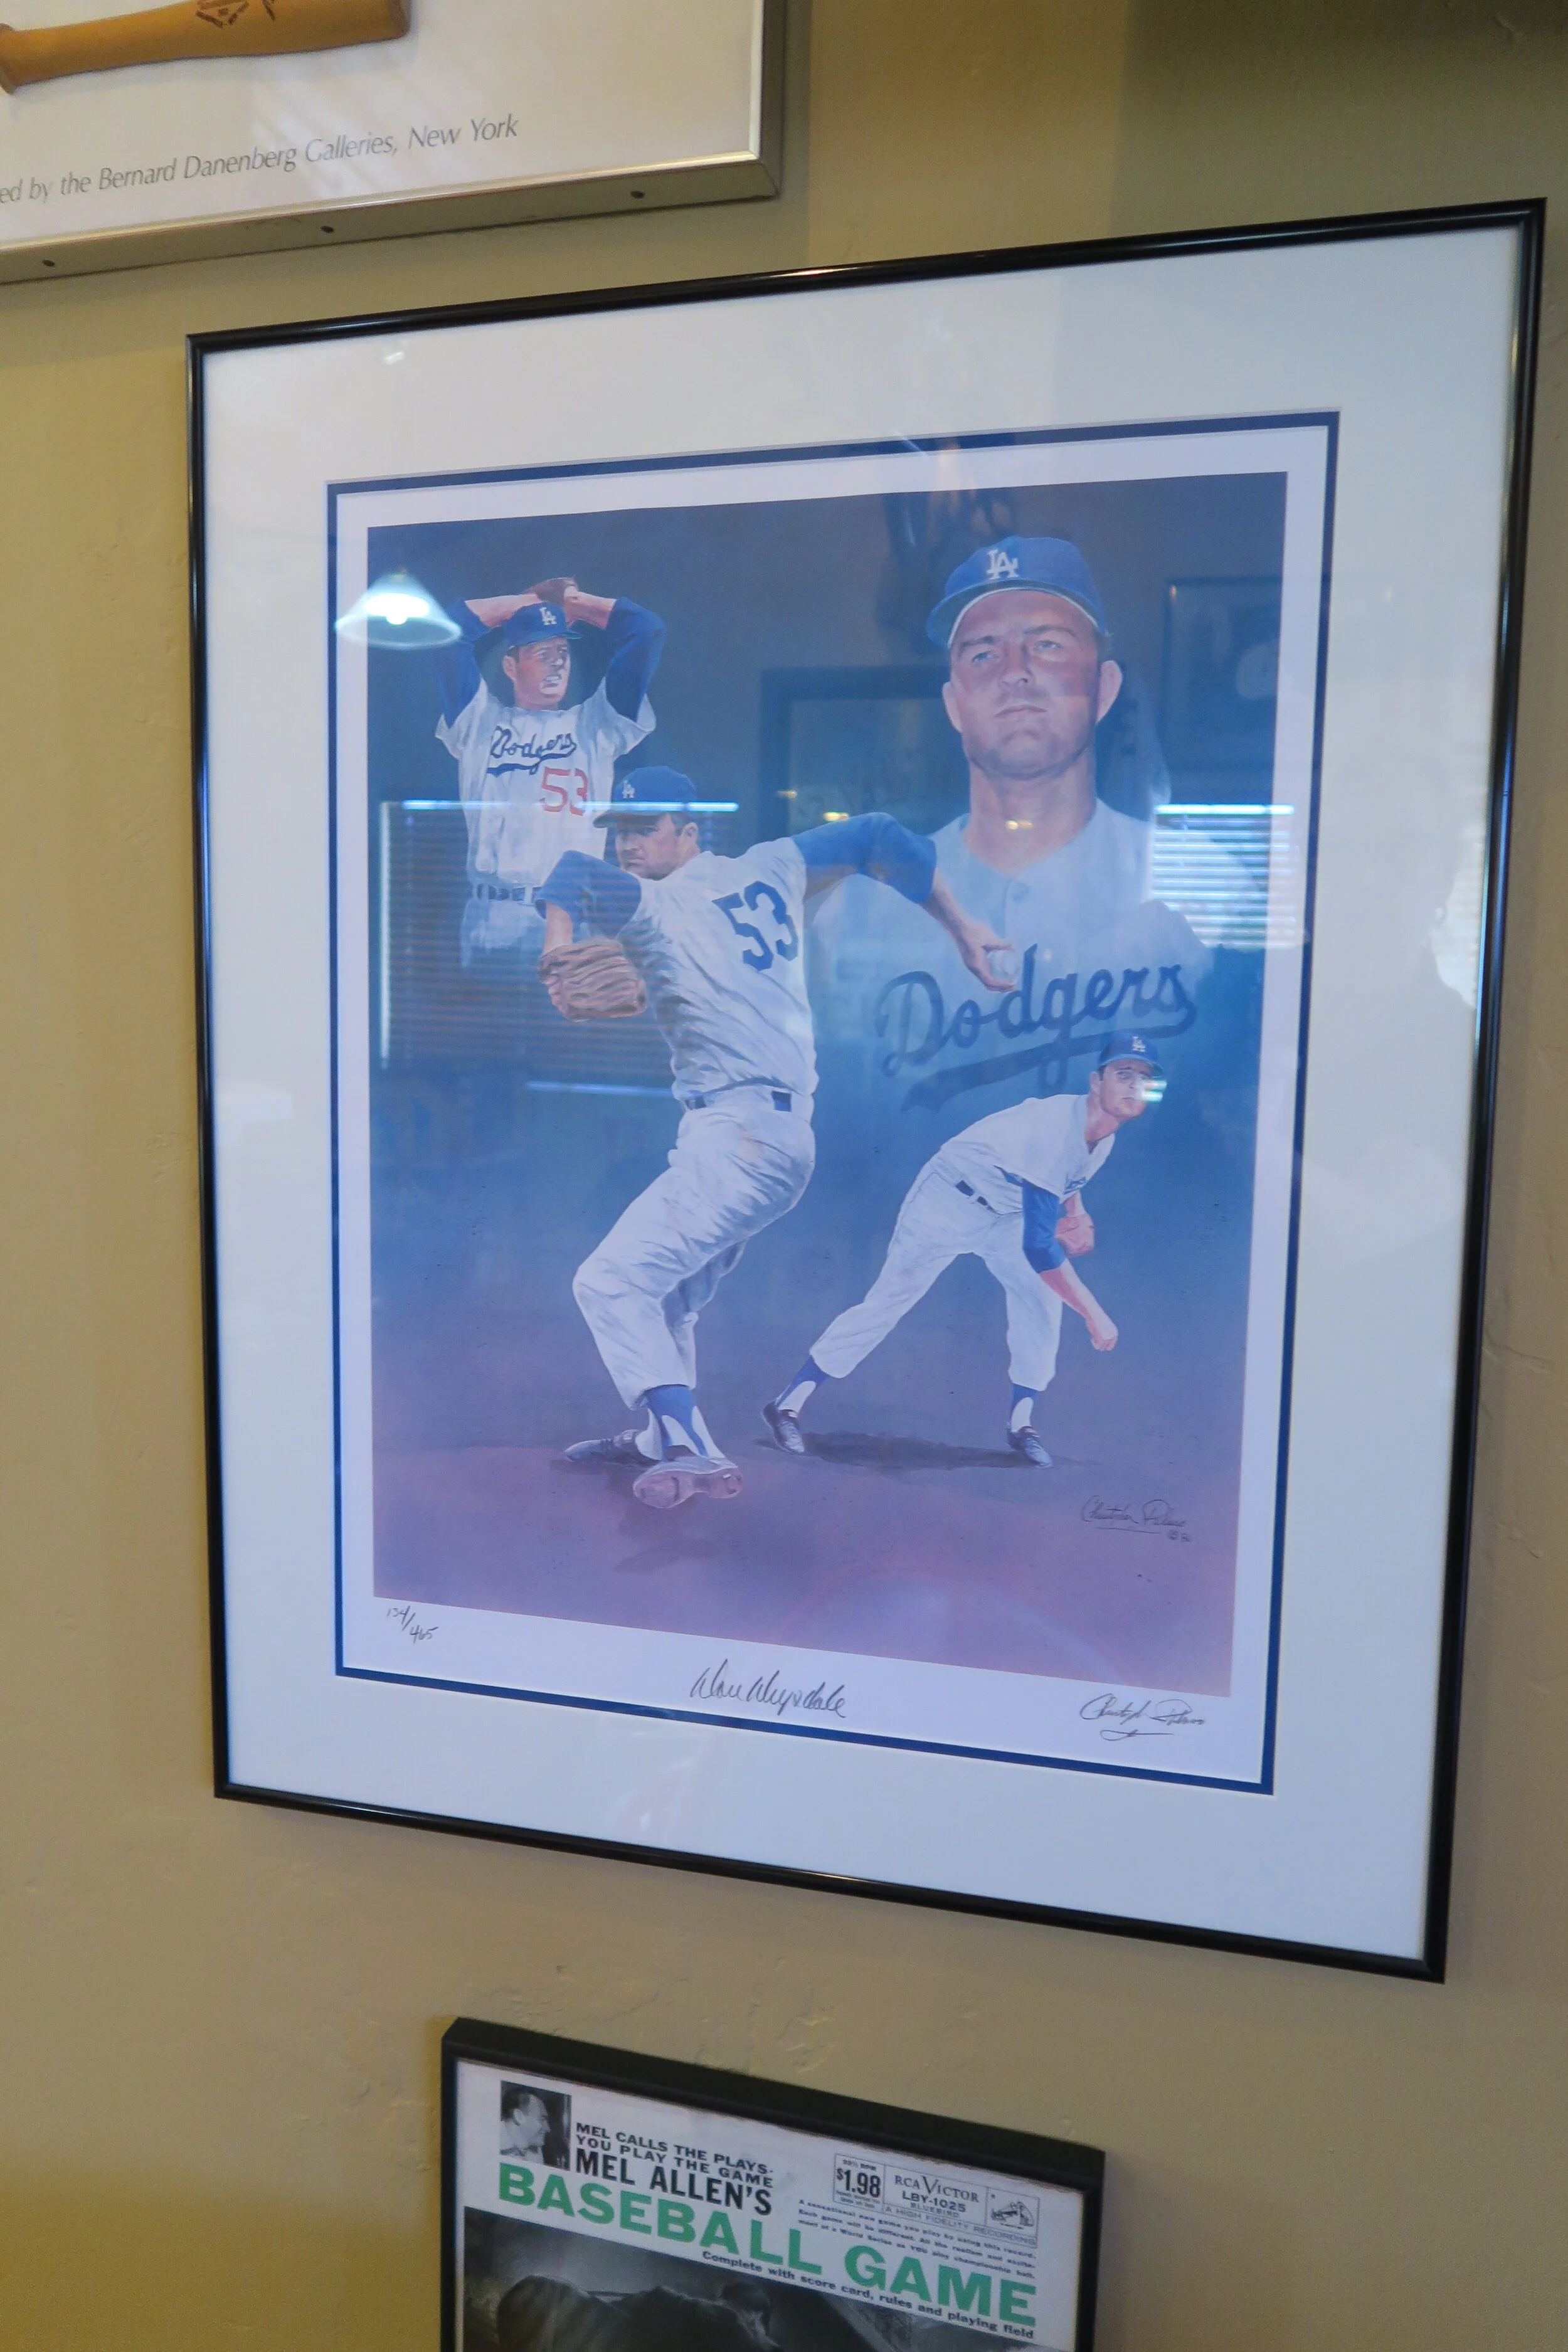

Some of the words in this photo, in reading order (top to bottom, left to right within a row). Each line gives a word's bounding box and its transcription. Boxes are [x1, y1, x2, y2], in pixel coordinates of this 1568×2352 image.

[29, 176, 53, 203] by
[61, 171, 92, 195] the
[97, 157, 177, 189] Bernard
[184, 146, 297, 172] Danenberg
[305, 131, 397, 162] Galleries,
[408, 125, 461, 149] New
[470, 114, 519, 141] York
[489, 724, 578, 775] Dodgers
[539, 767, 588, 816] 53
[713, 881, 798, 971] 53
[874, 943, 1198, 1091] Dodgers
[576, 2122, 610, 2139] MEL
[616, 2132, 668, 2151] CALLS
[674, 2144, 707, 2161] THE
[576, 2134, 611, 2151] YOU
[620, 2144, 665, 2164] PLAY
[674, 2156, 709, 2173] THE
[718, 2167, 773, 2188] GAME
[576, 2148, 635, 2185] MEL
[649, 2165, 773, 2216] ALLEN'S
[836, 2167, 881, 2198] $1.98
[895, 2175, 920, 2190] RCA
[903, 2191, 966, 2213] LBY-1025
[498, 2162, 822, 2275] BASEBALL
[845, 2245, 1037, 2327] GAME
[702, 2250, 762, 2273] Complete
[768, 2266, 795, 2281] with
[800, 2274, 835, 2291] score
[841, 2284, 874, 2301] card,
[879, 2293, 912, 2309] rules
[918, 2303, 943, 2318] and
[948, 2311, 997, 2333] playing
[1004, 2325, 1034, 2340] field
